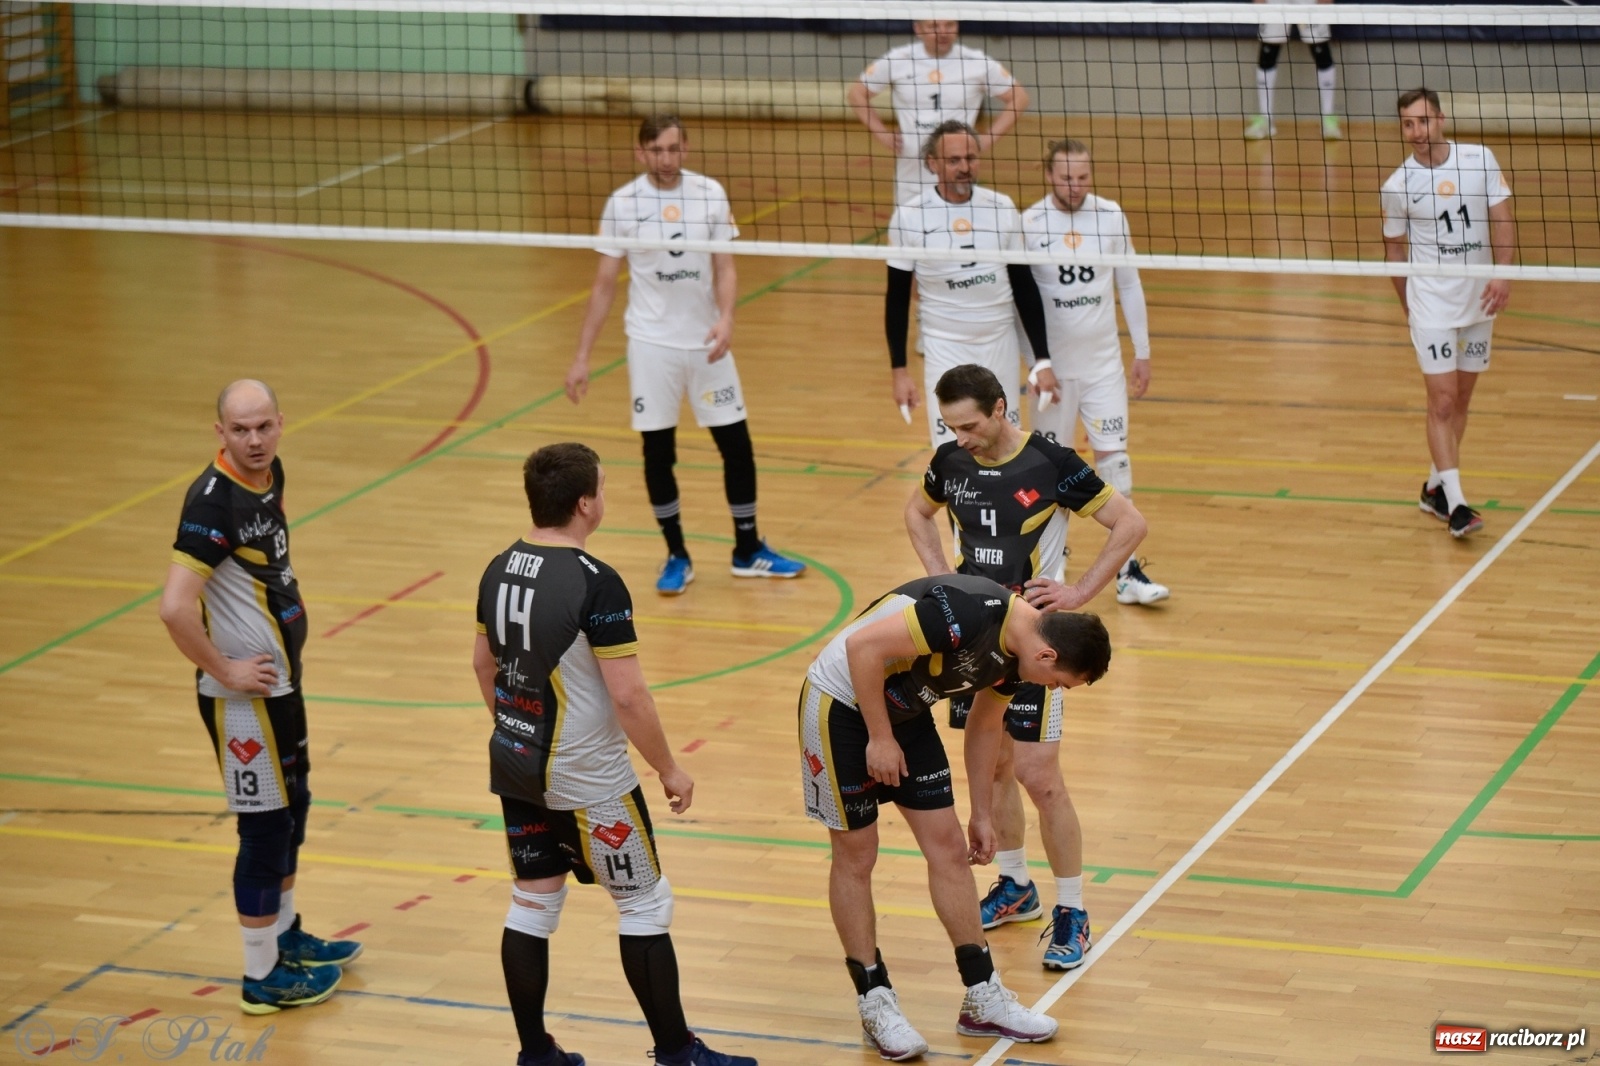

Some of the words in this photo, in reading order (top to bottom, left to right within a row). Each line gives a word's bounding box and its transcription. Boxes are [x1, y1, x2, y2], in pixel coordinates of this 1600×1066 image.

[930, 93, 942, 112] 1
[1438, 204, 1472, 234] 11
[946, 272, 997, 291] TropiDog
[1052, 295, 1102, 309] TropiDog
[1427, 342, 1453, 361] 16
[634, 397, 645, 414] 6
[980, 508, 997, 537] 4
[273, 528, 288, 560] 13
[505, 550, 545, 579] ENTER
[974, 547, 1004, 566] ENTER
[495, 582, 536, 652] 14
[233, 769, 260, 797] 13
[598, 826, 622, 842] Enter
[605, 853, 634, 881] 14
